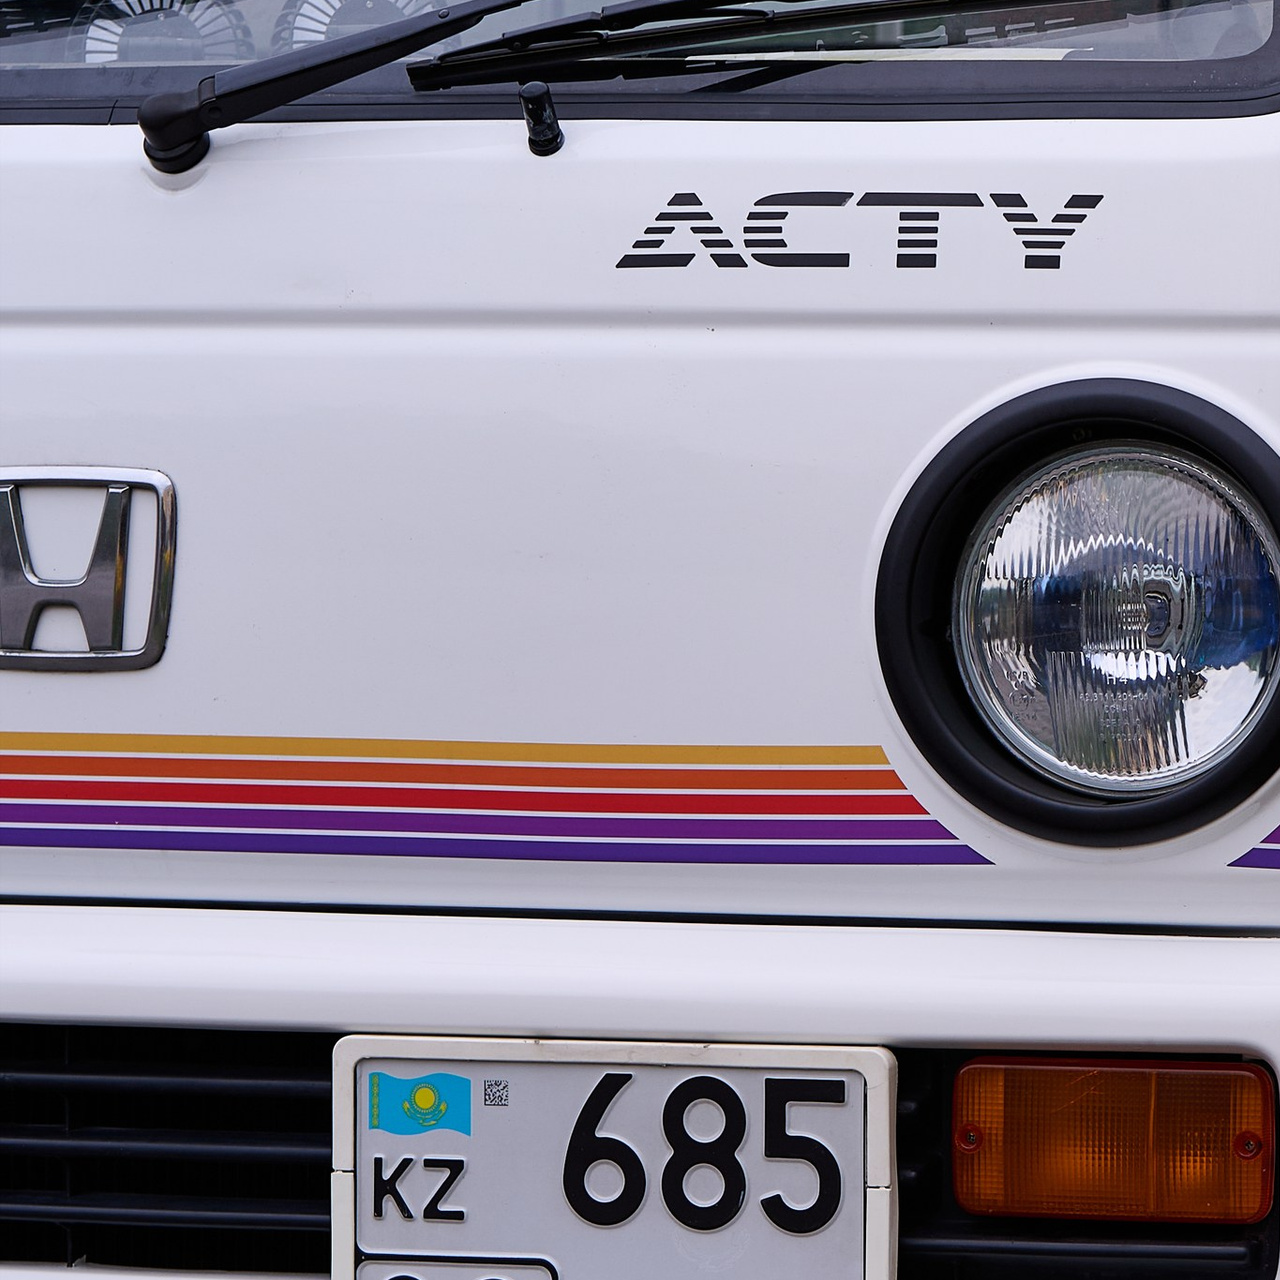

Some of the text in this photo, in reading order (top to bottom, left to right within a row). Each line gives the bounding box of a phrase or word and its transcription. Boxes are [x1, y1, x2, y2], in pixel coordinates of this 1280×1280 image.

[615, 191, 1104, 269] ACTY
[372, 1156, 465, 1220] KZ
[562, 1072, 846, 1234] 685
